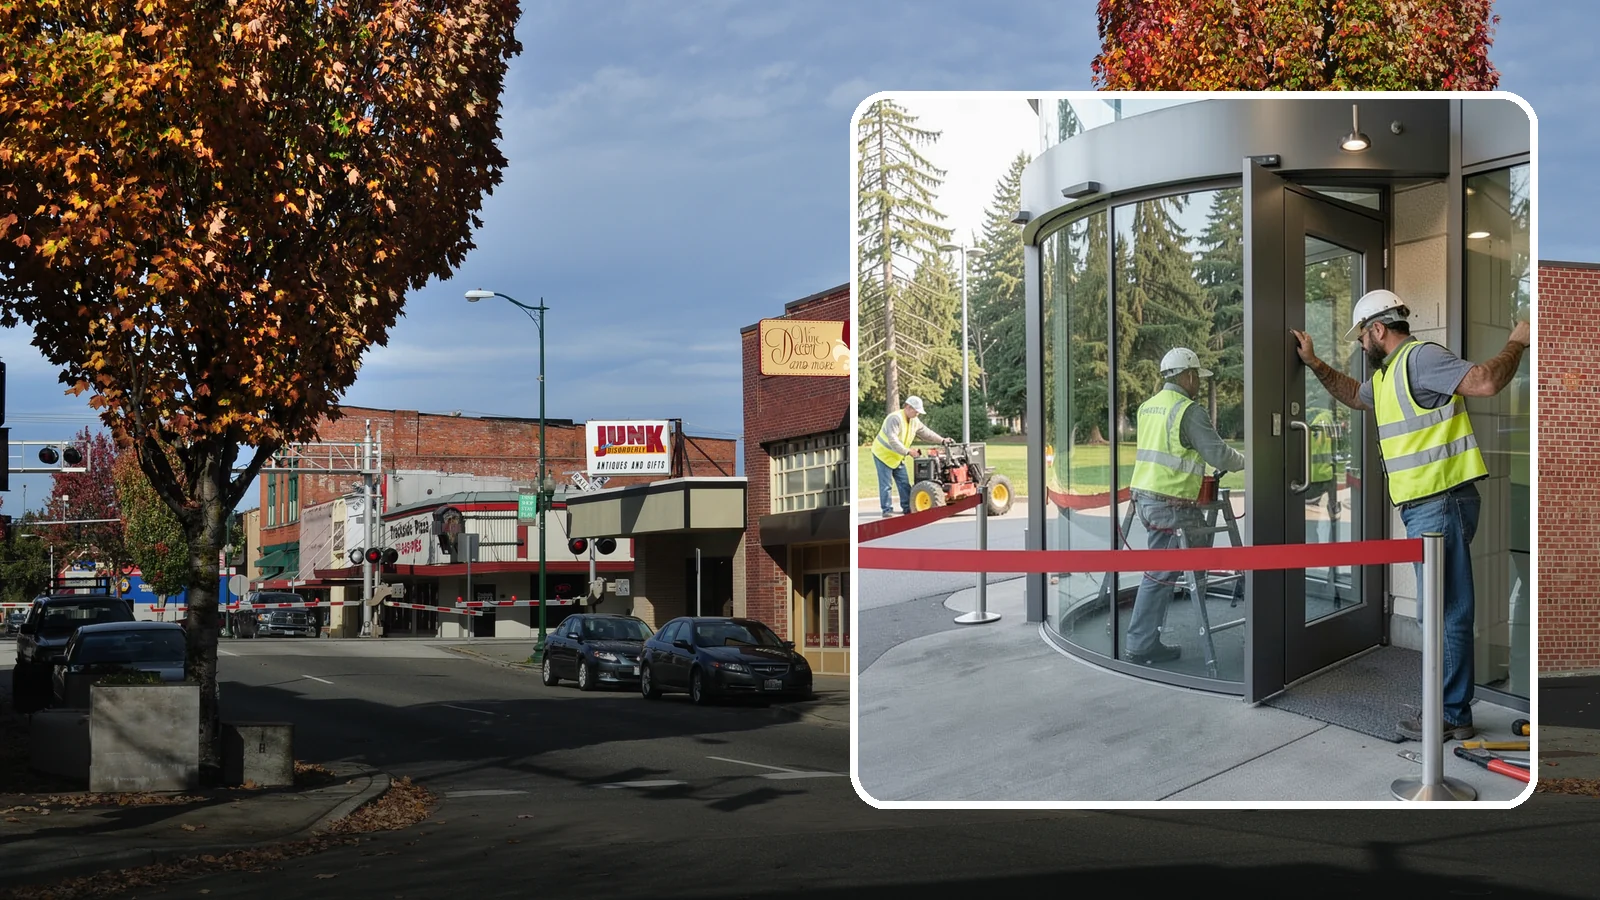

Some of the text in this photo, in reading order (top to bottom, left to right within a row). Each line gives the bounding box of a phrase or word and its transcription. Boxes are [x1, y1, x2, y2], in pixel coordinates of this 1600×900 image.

[596, 425, 665, 457] JUNK
[607, 446, 646, 454] DISORDERLY
[597, 460, 665, 470] ANTIQUES AND GIFTS
[414, 519, 429, 534] Pizza
